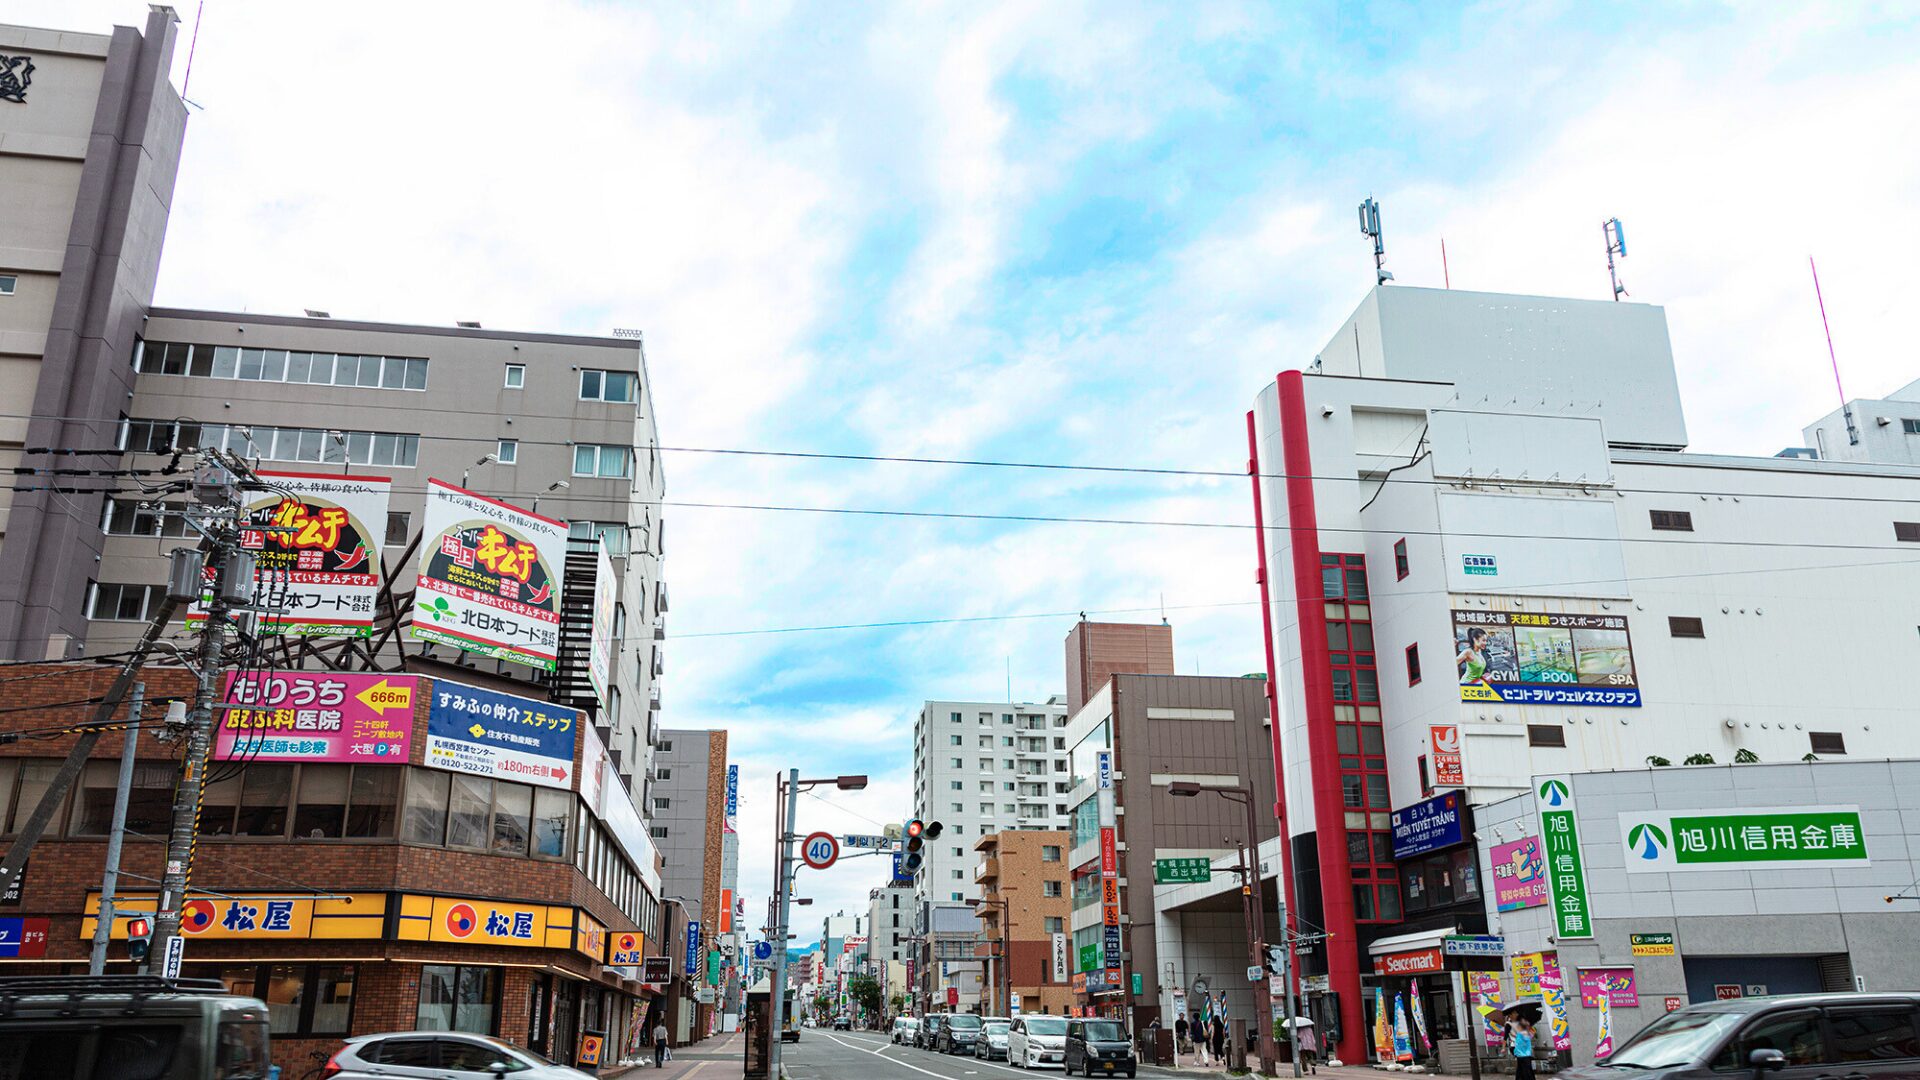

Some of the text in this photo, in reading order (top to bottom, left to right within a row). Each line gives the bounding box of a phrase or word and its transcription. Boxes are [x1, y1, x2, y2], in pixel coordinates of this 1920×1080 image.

[270, 501, 347, 549] キムチ
[456, 525, 484, 543] スーパー
[442, 535, 474, 568] 極上
[476, 527, 537, 581] キムチ
[1464, 557, 1495, 566] 広告募集
[461, 609, 541, 642] 北日本フード
[1456, 612, 1507, 624] 地域最大級
[1490, 670, 1520, 682] GYM
[1541, 672, 1578, 684] POOL
[1608, 674, 1635, 686] SPA
[233, 676, 347, 706] もりうち
[370, 691, 408, 704] 666m
[1463, 688, 1492, 698] ここ右折
[1502, 688, 1637, 704] セントラルウェルネスクラブ
[226, 708, 342, 731] 皮ふ科医院
[487, 729, 541, 748] 住友不動産販売
[233, 740, 328, 755] 女性医師も診察
[440, 758, 494, 775] 0120-522-271
[1439, 774, 1463, 783] たばこ
[728, 766, 738, 815] ハシモトビル
[1679, 823, 1860, 854] 旭川信用金庫
[809, 841, 831, 860] 40
[1170, 867, 1208, 877] 西出張所
[1549, 814, 1585, 933] 旭川信用金庫
[222, 900, 295, 932] 松屋
[484, 909, 536, 940] 松屋
[613, 951, 640, 964] 松屋
[1717, 988, 1740, 996] ATM
